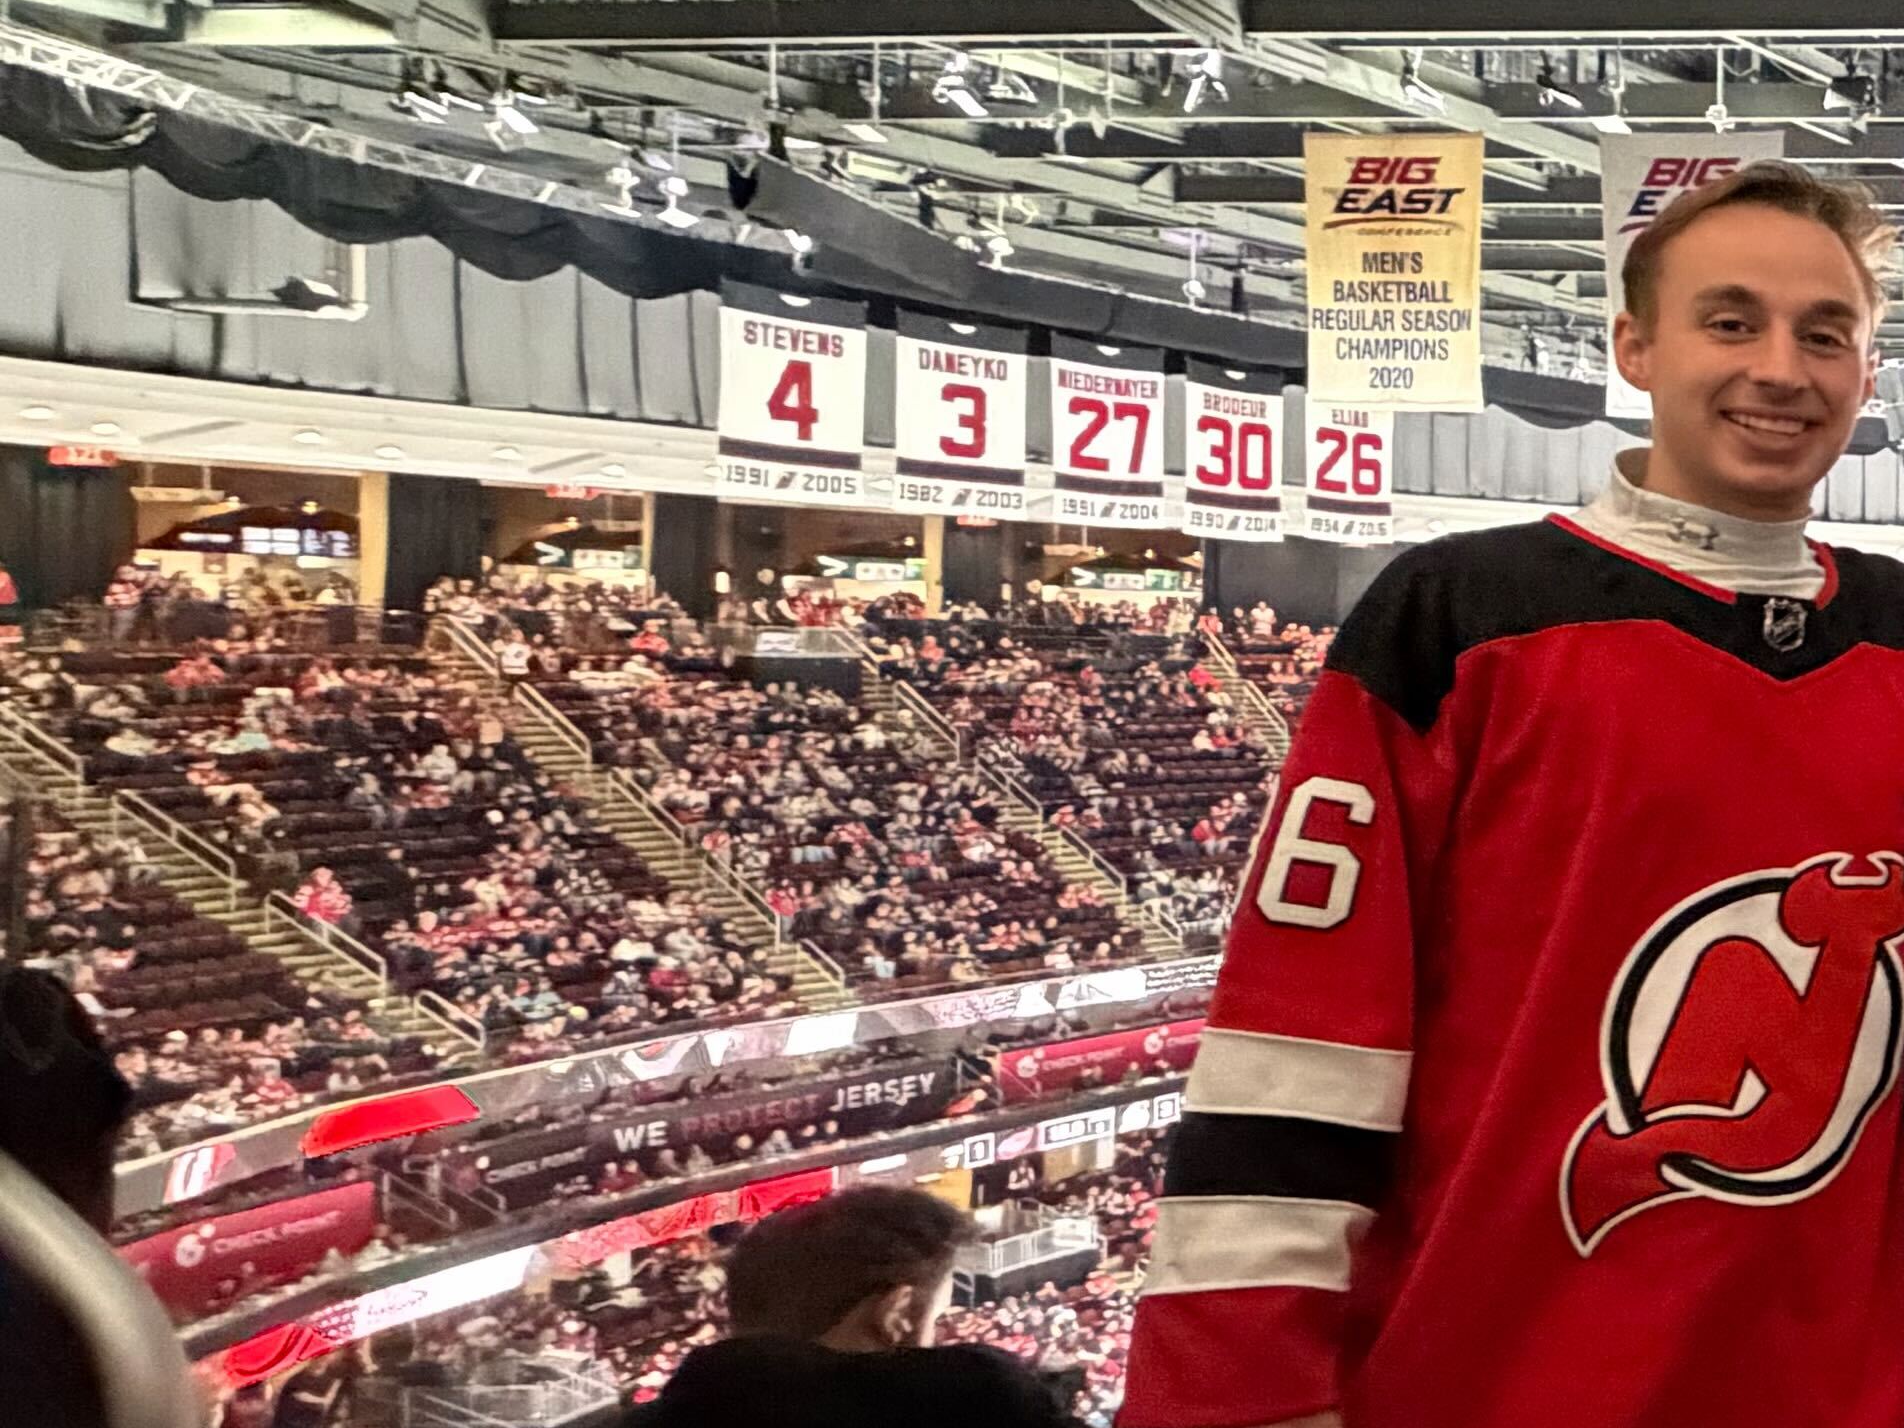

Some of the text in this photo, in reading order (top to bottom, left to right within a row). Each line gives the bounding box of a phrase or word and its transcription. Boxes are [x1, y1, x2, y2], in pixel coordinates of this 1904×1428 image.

[1347, 156, 1442, 185] BIG
[1333, 188, 1465, 214] EAST
[1362, 251, 1423, 274] MEN'S
[1333, 280, 1453, 303] BASKETBALL
[1312, 308, 1472, 332] REGULAR SEASON
[743, 320, 844, 358] STEVENS
[1336, 337, 1449, 361] CHAMPIONS
[919, 347, 1008, 381] DANEYKO
[1369, 366, 1414, 390] 2020
[767, 360, 819, 441] 4
[1203, 392, 1267, 418] BRODEUR
[940, 383, 987, 459] 3
[1068, 396, 1150, 474] 27
[1196, 415, 1272, 490] 30
[1316, 426, 1382, 495] 26
[803, 474, 857, 495] 2005
[976, 490, 1023, 509] 2003
[1120, 503, 1158, 520] 2004
[1240, 775, 1376, 929] 6
[613, 1121, 668, 1153] WE
[829, 1072, 936, 1112] JERSEY
